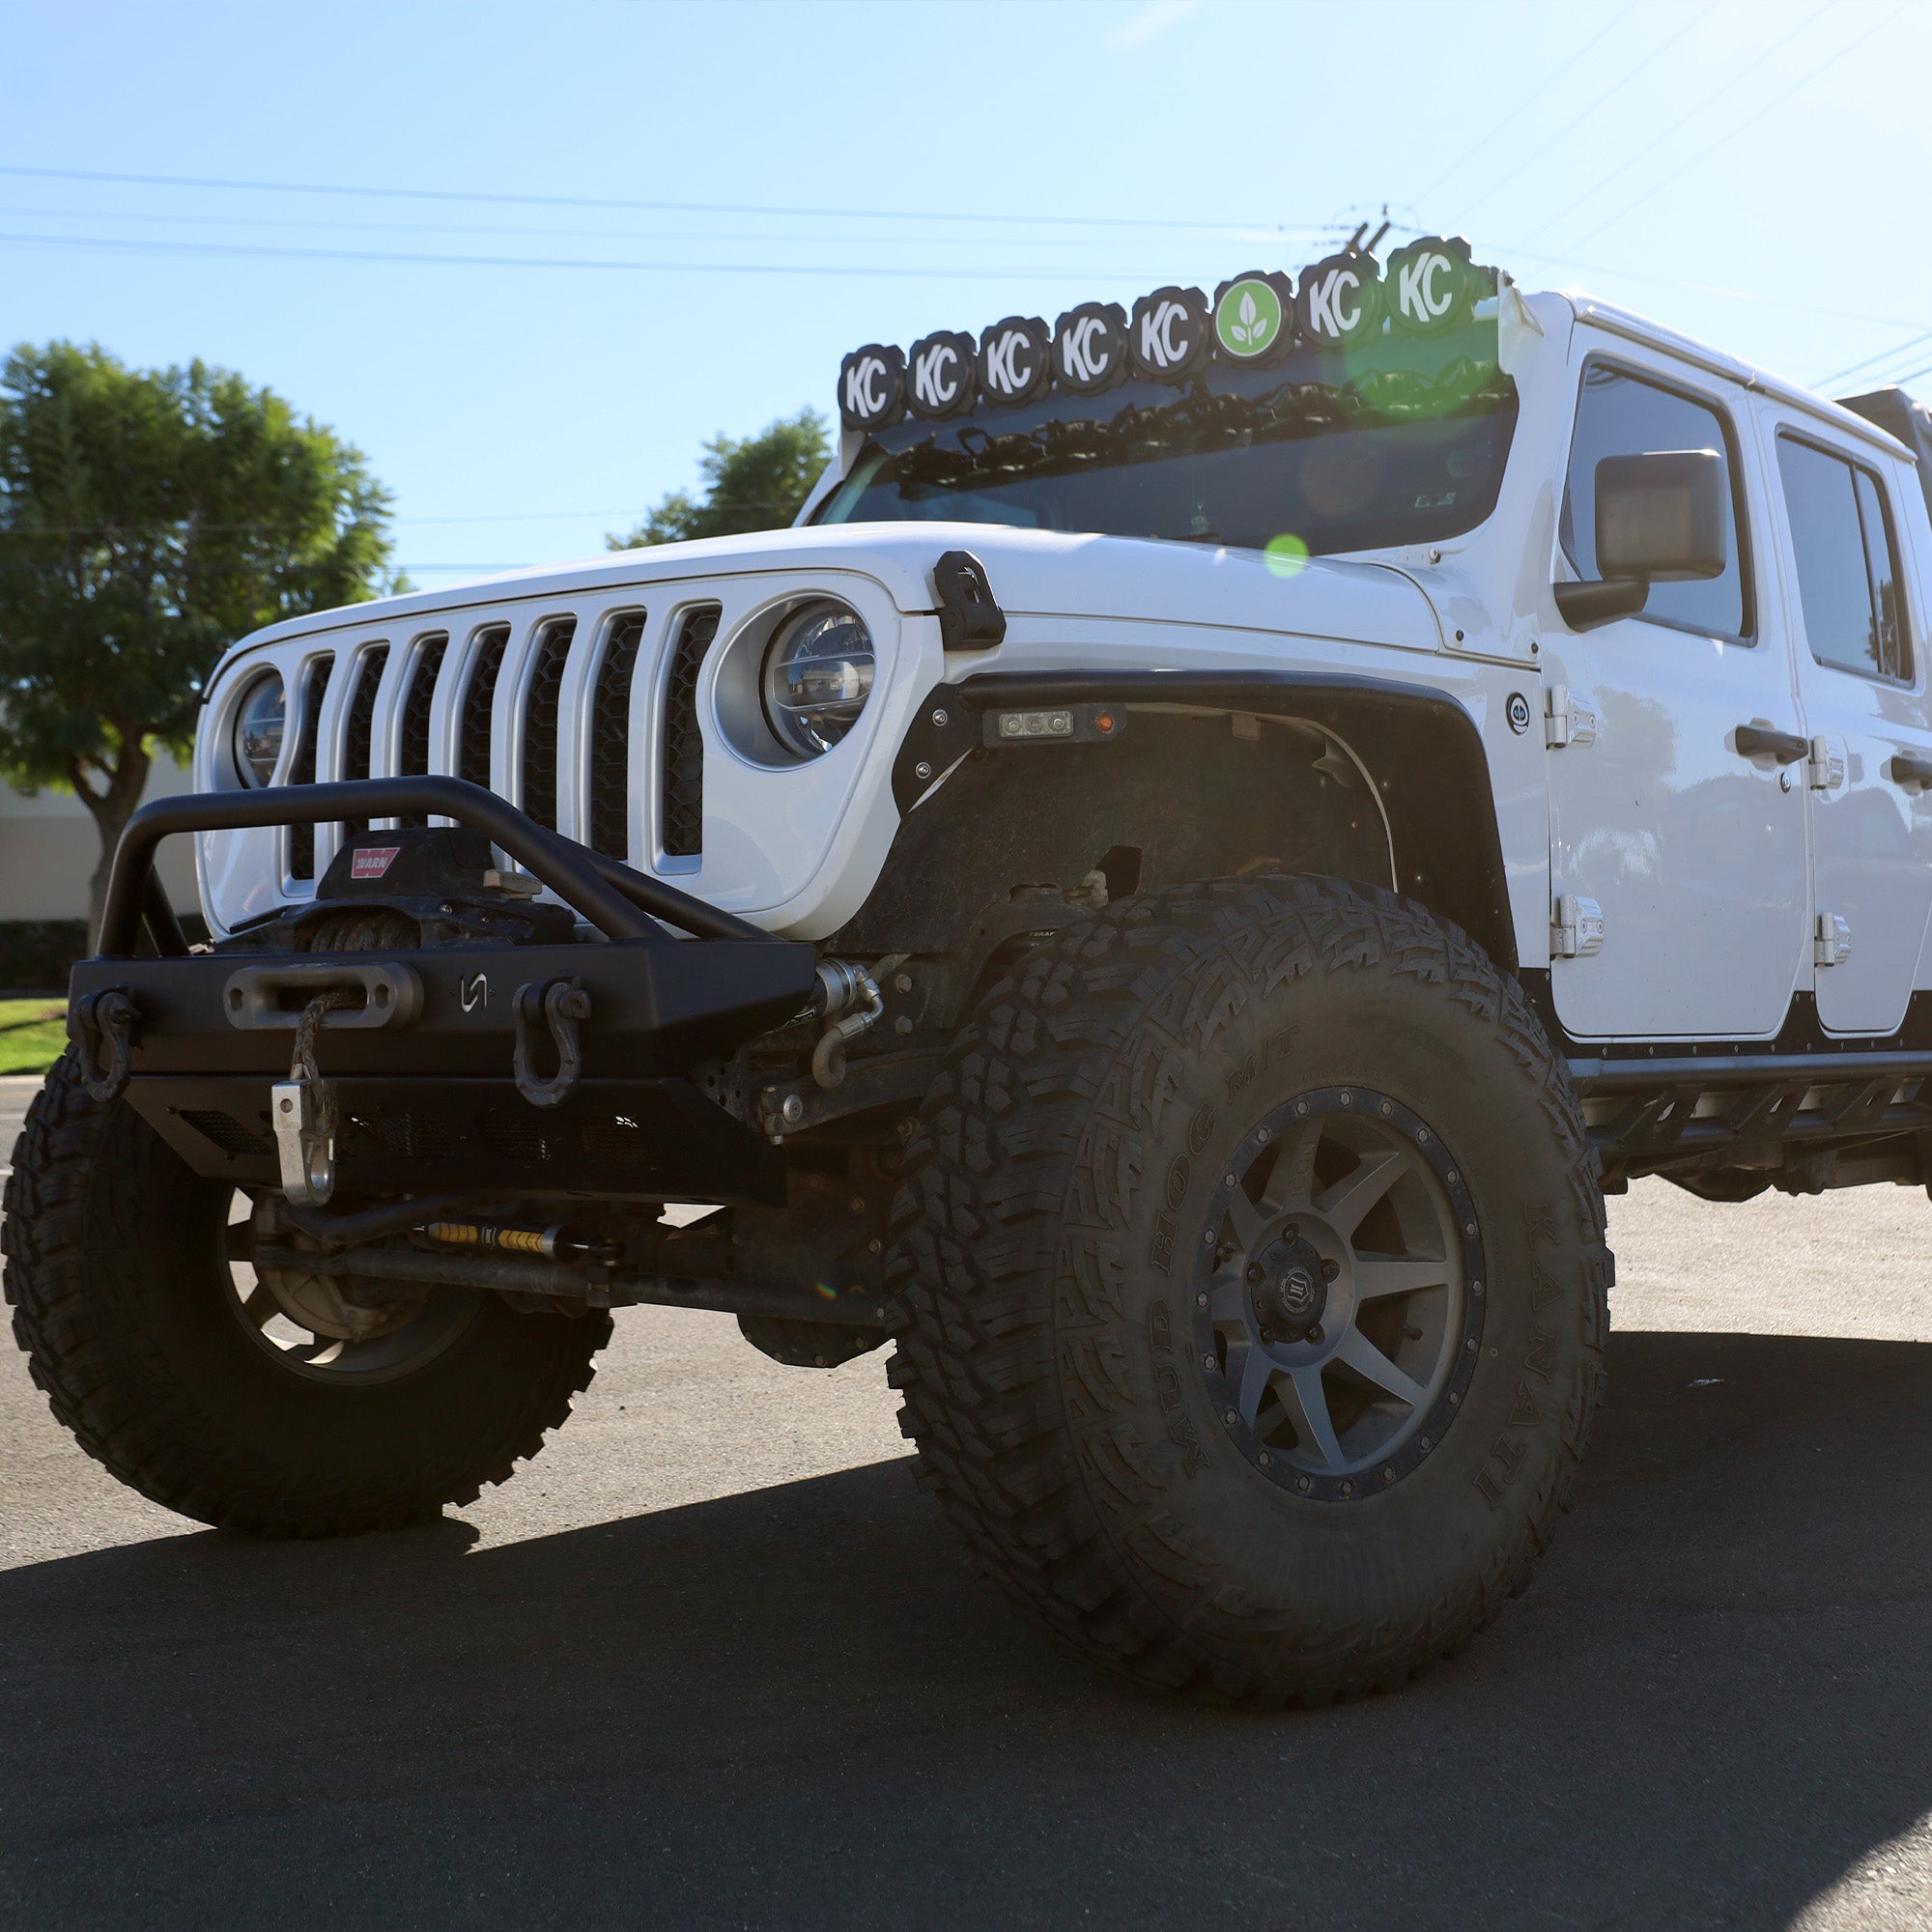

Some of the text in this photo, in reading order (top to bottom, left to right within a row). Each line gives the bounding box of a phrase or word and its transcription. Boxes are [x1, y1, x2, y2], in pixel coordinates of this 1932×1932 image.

[1309, 269, 1361, 337] KC
[1400, 252, 1453, 323] KC
[987, 330, 1032, 394] KC
[1063, 316, 1109, 382] KC
[1141, 300, 1189, 367] KC
[846, 356, 887, 418] KC
[916, 344, 957, 407] KC
[355, 857, 388, 869] WARN
[1151, 1103, 1217, 1278] HOG
[1149, 1298, 1211, 1479] MUD
[1473, 1204, 1562, 1511] KANATI
